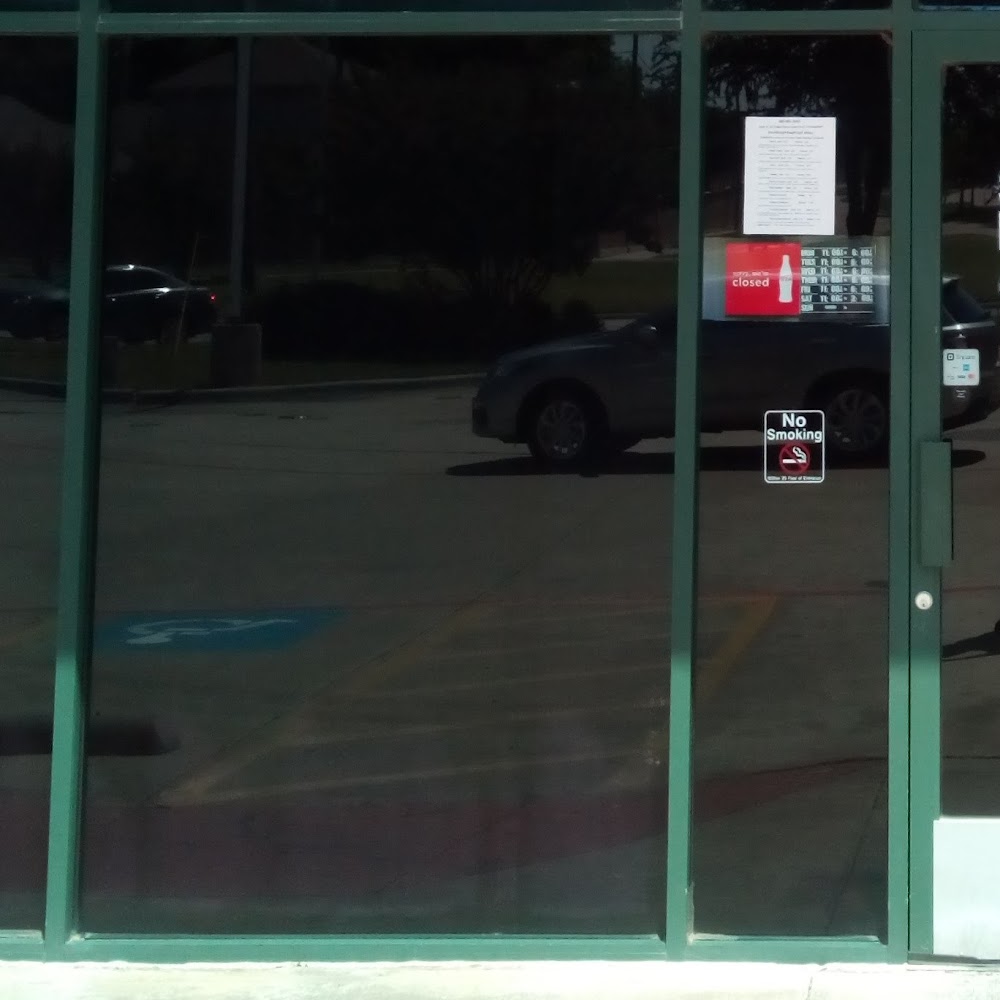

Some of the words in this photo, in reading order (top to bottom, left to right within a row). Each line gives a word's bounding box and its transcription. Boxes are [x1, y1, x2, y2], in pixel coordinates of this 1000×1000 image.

[732, 277, 770, 287] closed
[782, 412, 807, 427] No
[767, 428, 823, 443] Smoking
